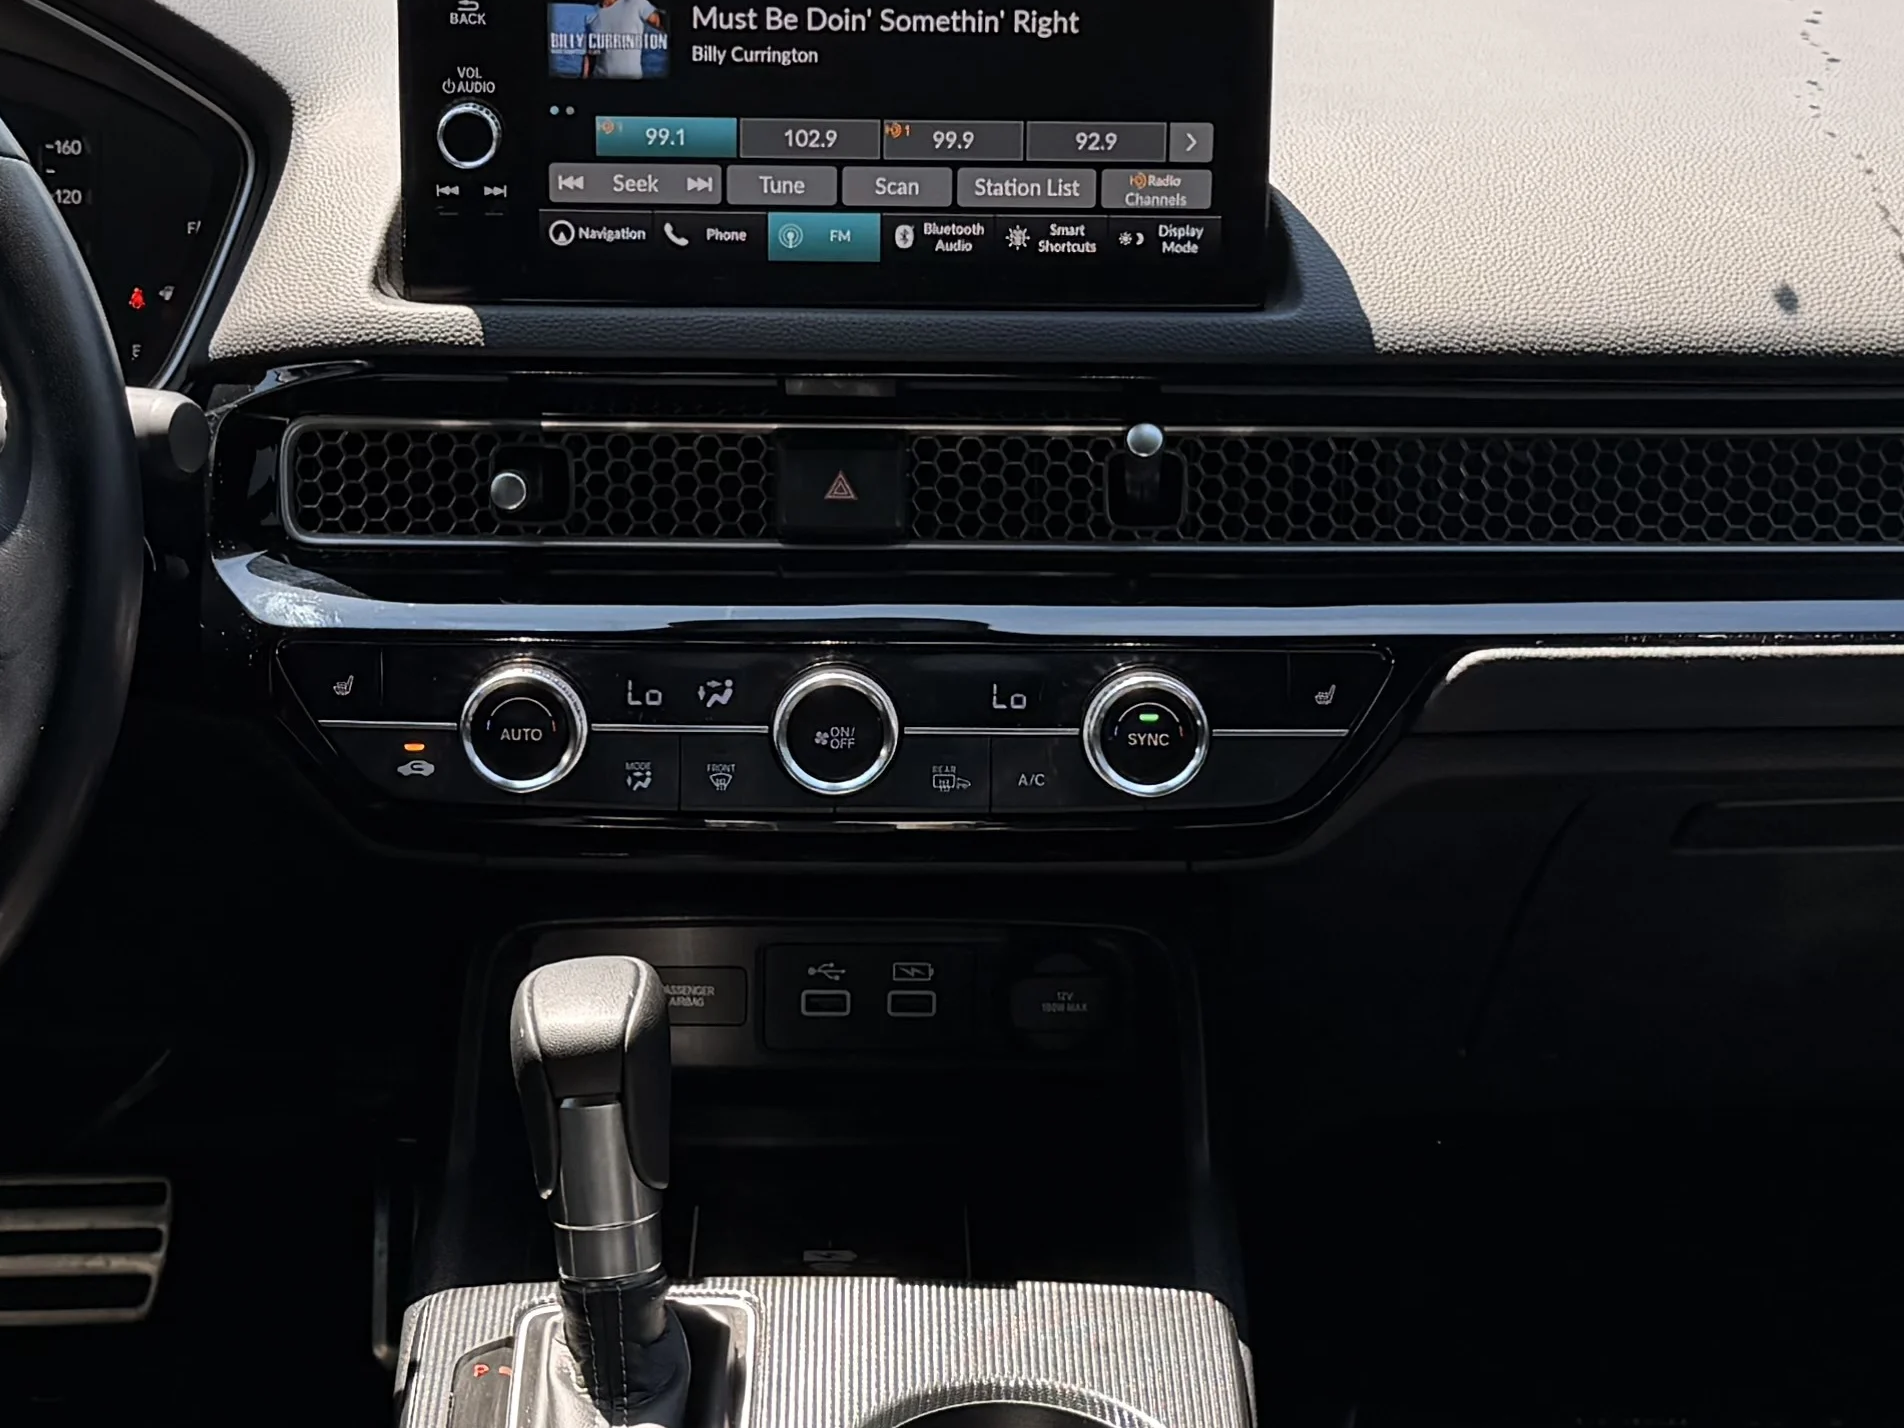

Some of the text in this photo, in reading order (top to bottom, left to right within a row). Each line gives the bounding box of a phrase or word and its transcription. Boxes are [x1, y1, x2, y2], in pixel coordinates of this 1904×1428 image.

[449, 13, 486, 25] BACK
[692, 6, 1080, 39] Must Be Doin' Somethin' Right
[550, 32, 668, 50] BILLY CURRINGTON
[692, 45, 819, 66] Billy Currington
[457, 66, 483, 79] VOL
[457, 81, 496, 94] AUDIO
[646, 128, 686, 146] 99.1
[784, 129, 838, 148] 102.9
[932, 130, 975, 150] 99.9
[1075, 132, 1118, 152] 92.9
[52, 139, 83, 156] 160
[613, 174, 659, 193] Seek
[759, 175, 805, 194] Tune
[874, 178, 920, 196] Scan
[974, 178, 1081, 197] Station List
[1148, 174, 1181, 187] Radio
[54, 188, 83, 206] 120
[1125, 193, 1187, 208] Channels
[578, 227, 646, 241] Navigation
[706, 228, 747, 242] Phone
[829, 229, 852, 243] FM
[923, 222, 984, 236] Bluetooth
[1049, 223, 1086, 237] Smart
[1158, 224, 1204, 240] Display
[934, 239, 973, 253] Audio
[1038, 240, 1096, 254] Shortcuts
[1162, 241, 1199, 254] Mode
[627, 679, 663, 706] Lo
[992, 683, 1027, 710] Lo
[500, 728, 543, 741] AUTO
[830, 726, 856, 738] ON/
[830, 738, 856, 749] OFF
[1127, 733, 1170, 747] SYNC
[625, 761, 652, 771] MODE
[706, 763, 736, 773] FRONT
[1018, 773, 1046, 787] A/C
[662, 984, 715, 996] ASSENGER
[472, 1364, 490, 1380] P
